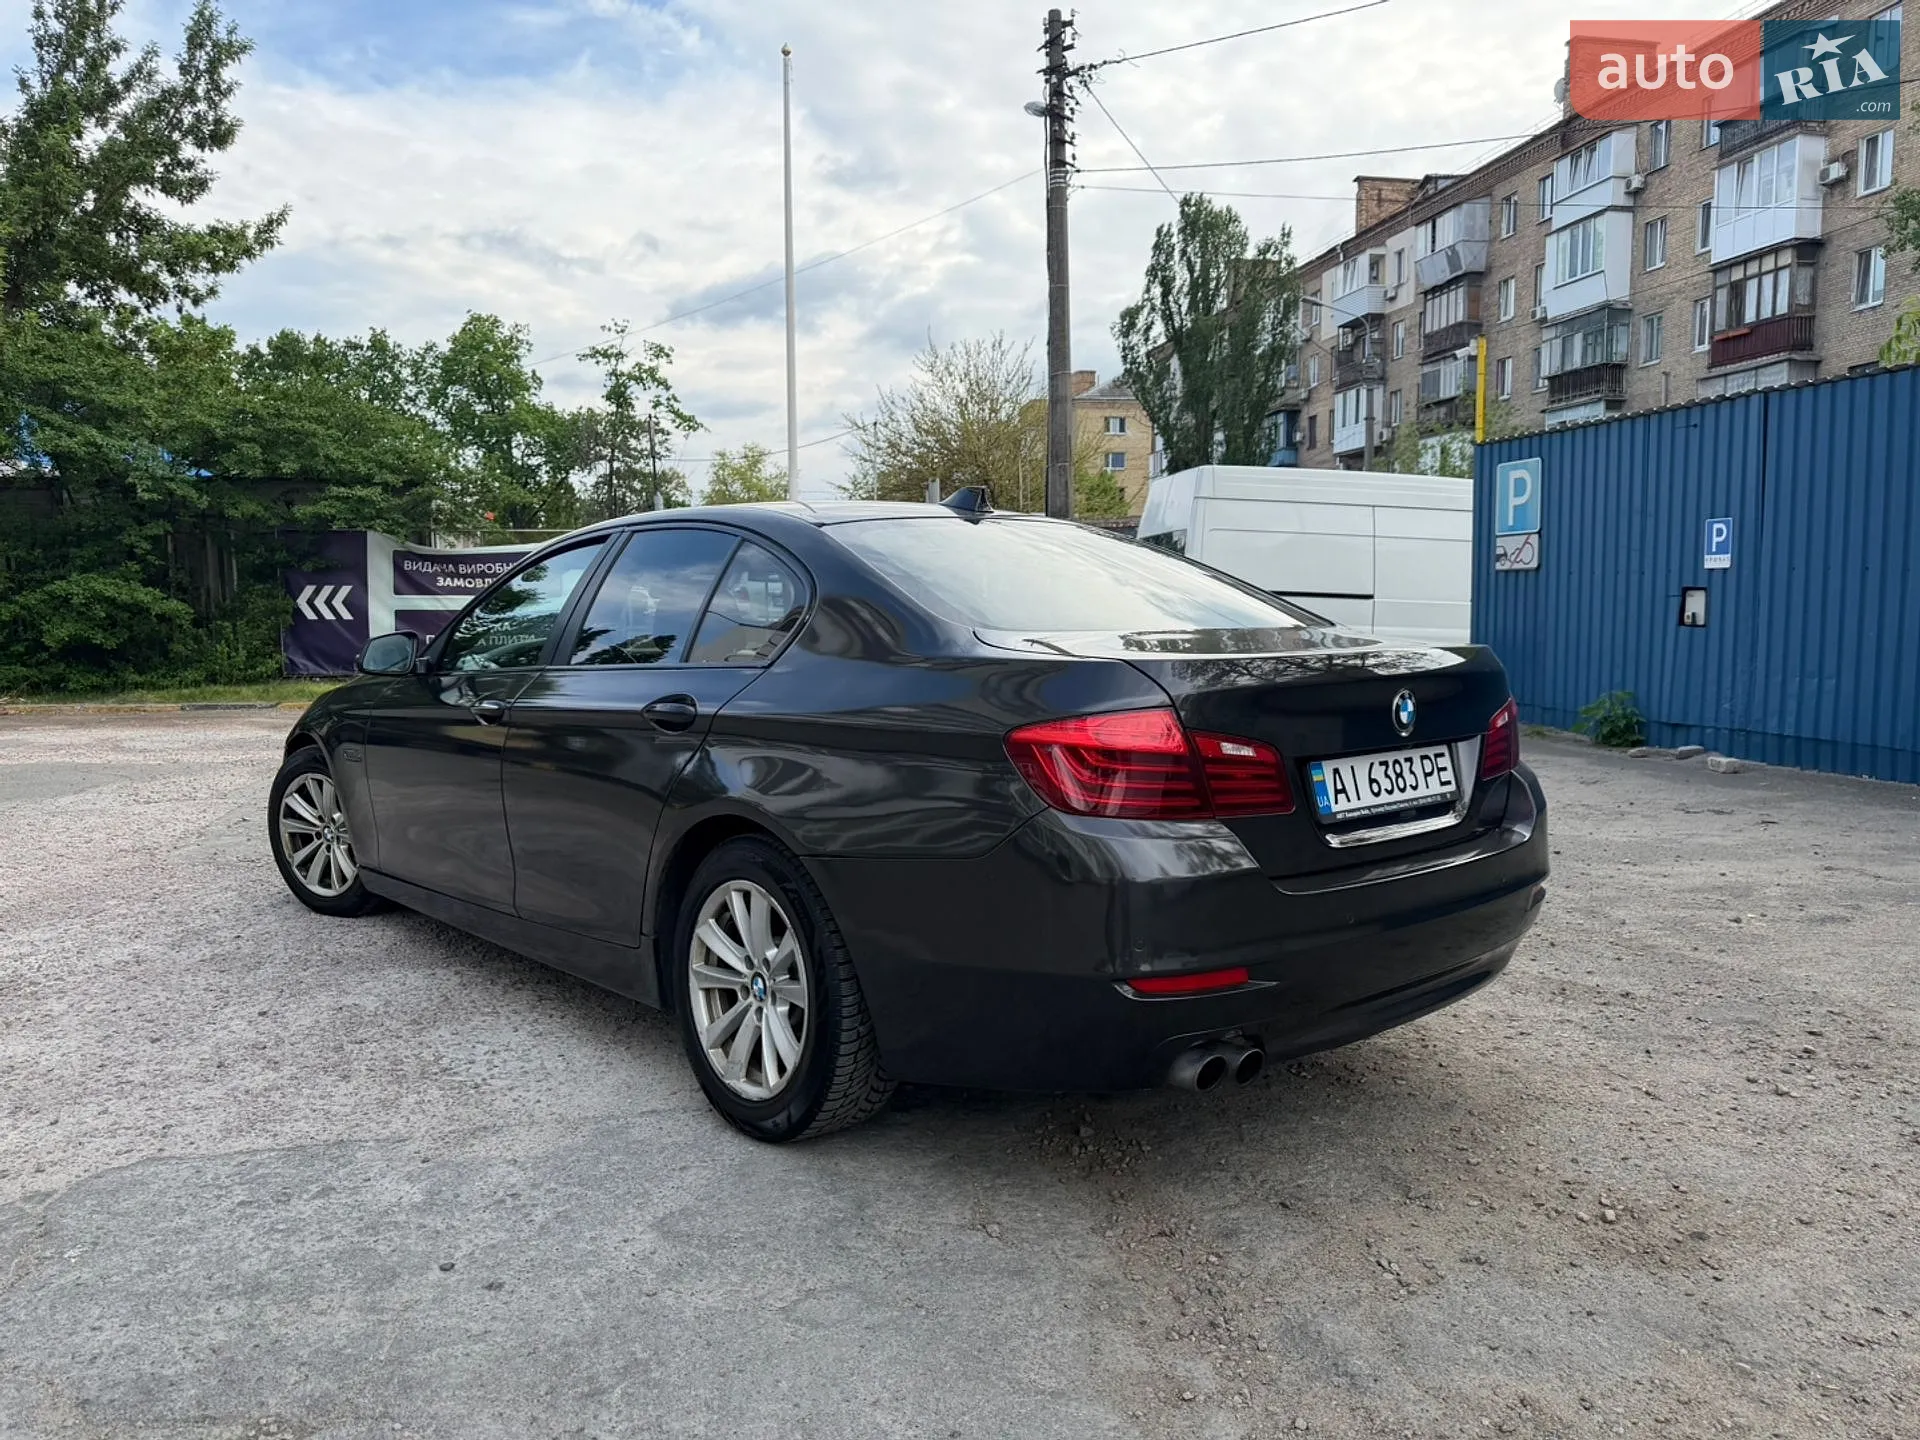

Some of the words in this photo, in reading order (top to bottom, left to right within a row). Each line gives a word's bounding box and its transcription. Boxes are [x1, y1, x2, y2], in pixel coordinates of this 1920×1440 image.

[1508, 469, 1532, 527] P
[1712, 522, 1727, 552] P
[403, 560, 456, 573] ВИДАЧА
[458, 562, 517, 575] ВИРОБН
[436, 576, 497, 588] ЗАМОВЛ
[1368, 756, 1419, 798] 6383
[1420, 752, 1452, 789] PE
[1317, 795, 1331, 808] UA
